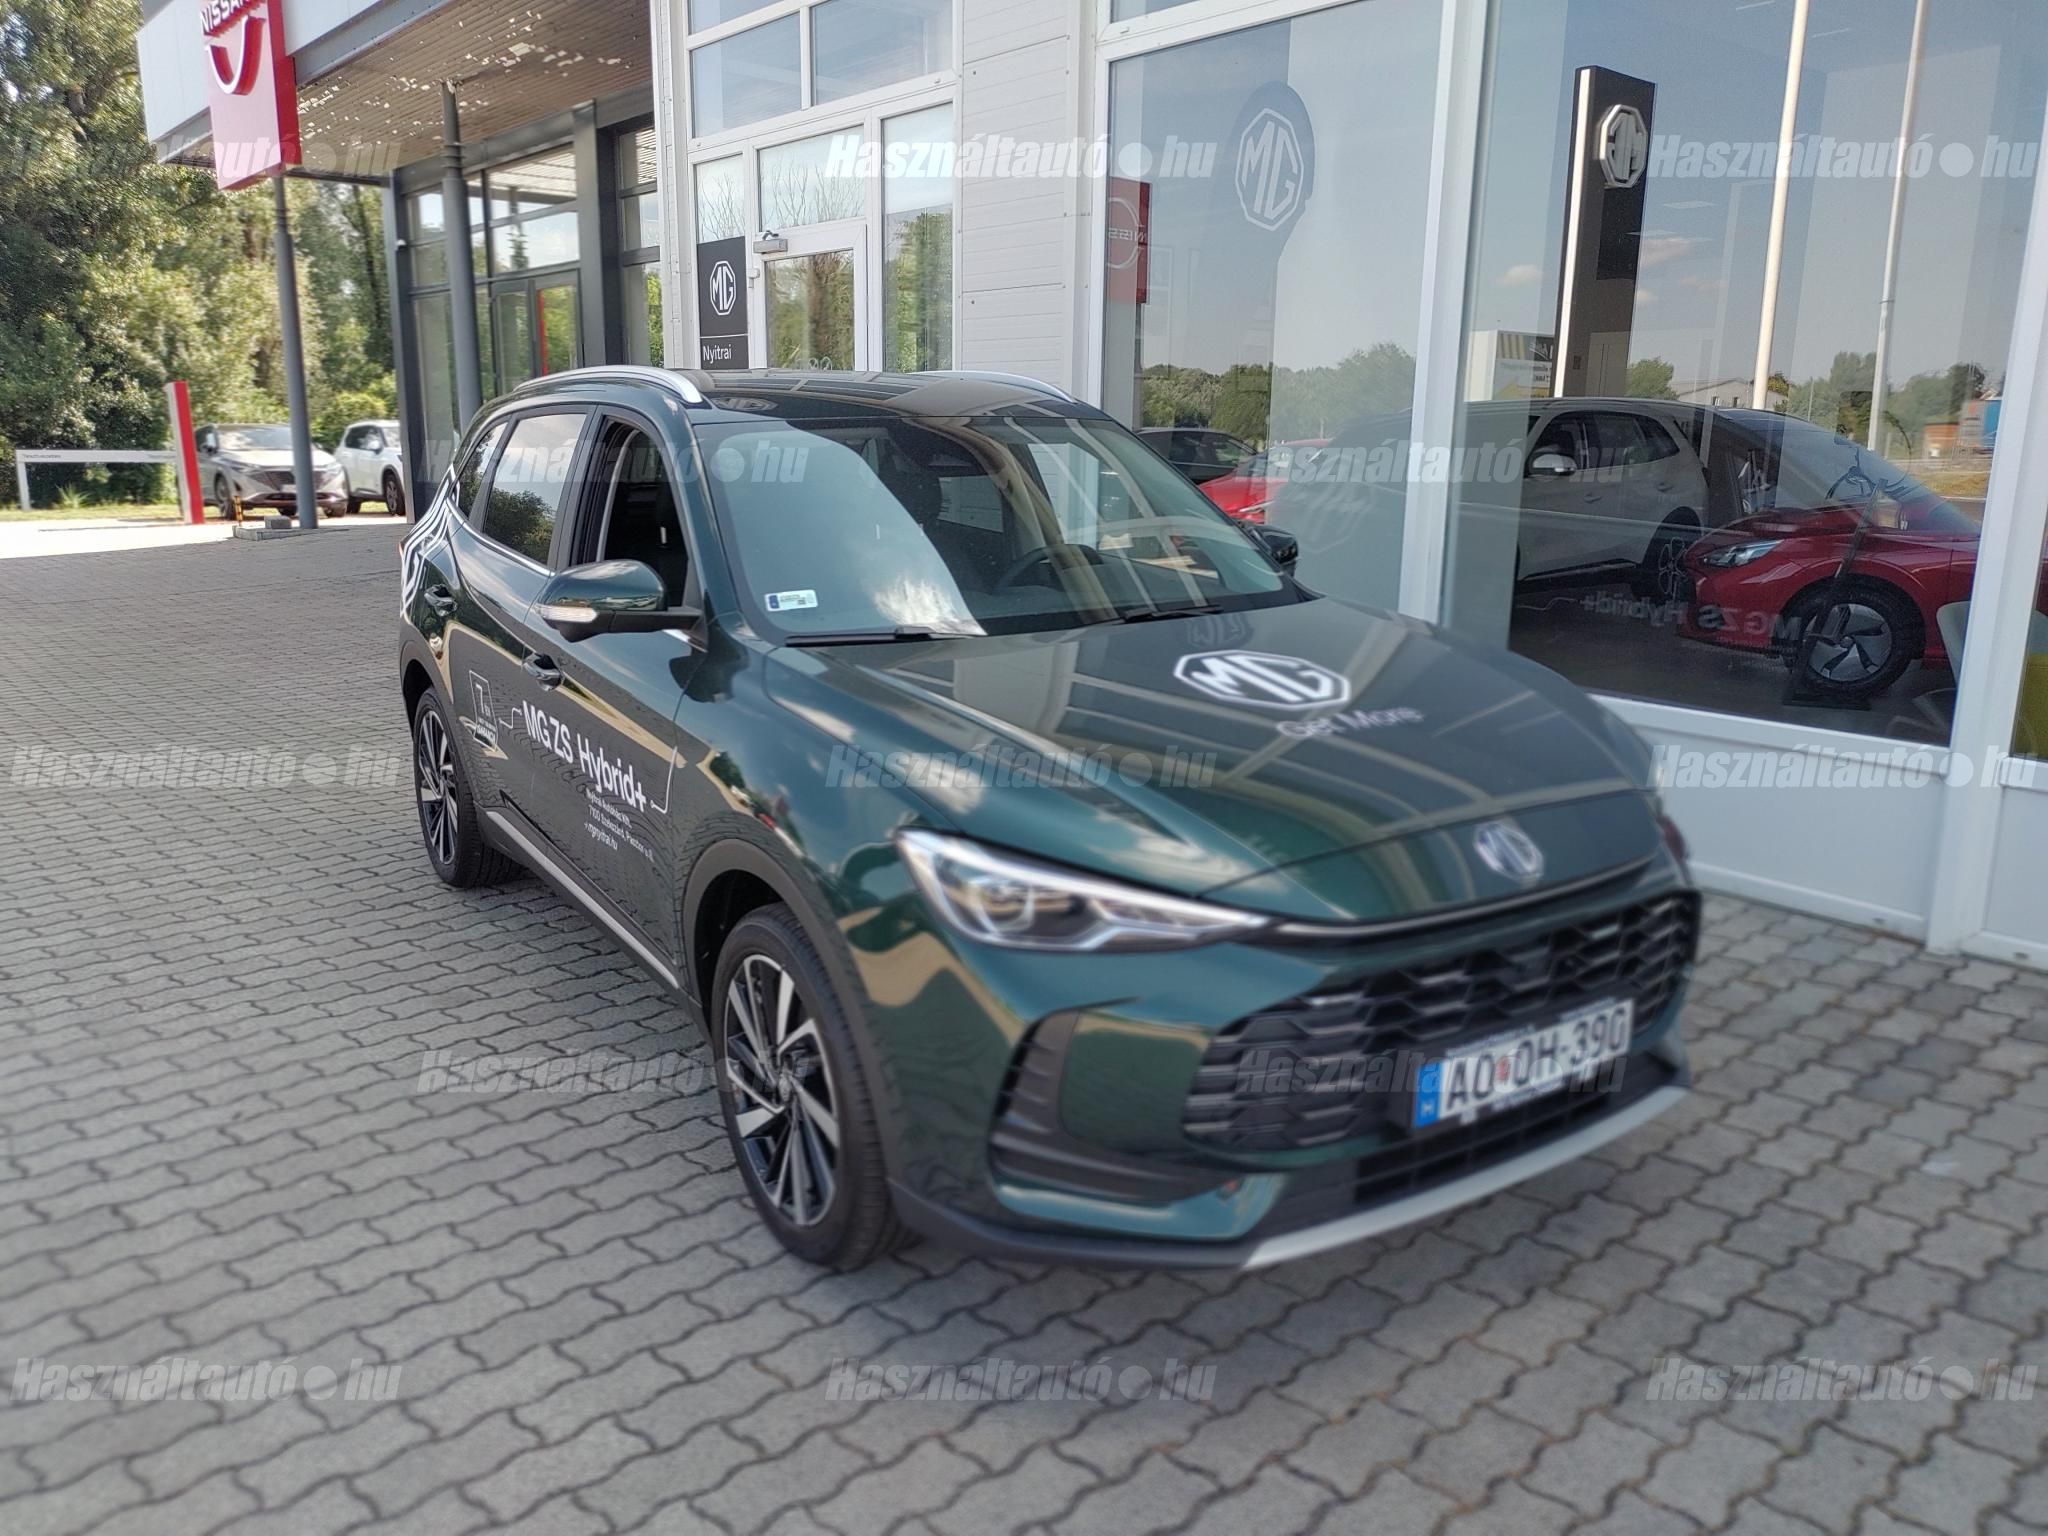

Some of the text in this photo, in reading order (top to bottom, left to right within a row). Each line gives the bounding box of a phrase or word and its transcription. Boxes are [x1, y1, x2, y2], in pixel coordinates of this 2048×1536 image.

[200, 0, 249, 33] NISS
[1242, 121, 1298, 219] MG
[711, 265, 734, 312] MG
[702, 343, 732, 364] Nyitrai
[1191, 655, 1334, 701] MG
[523, 700, 646, 812] MG ZS Hybrid+
